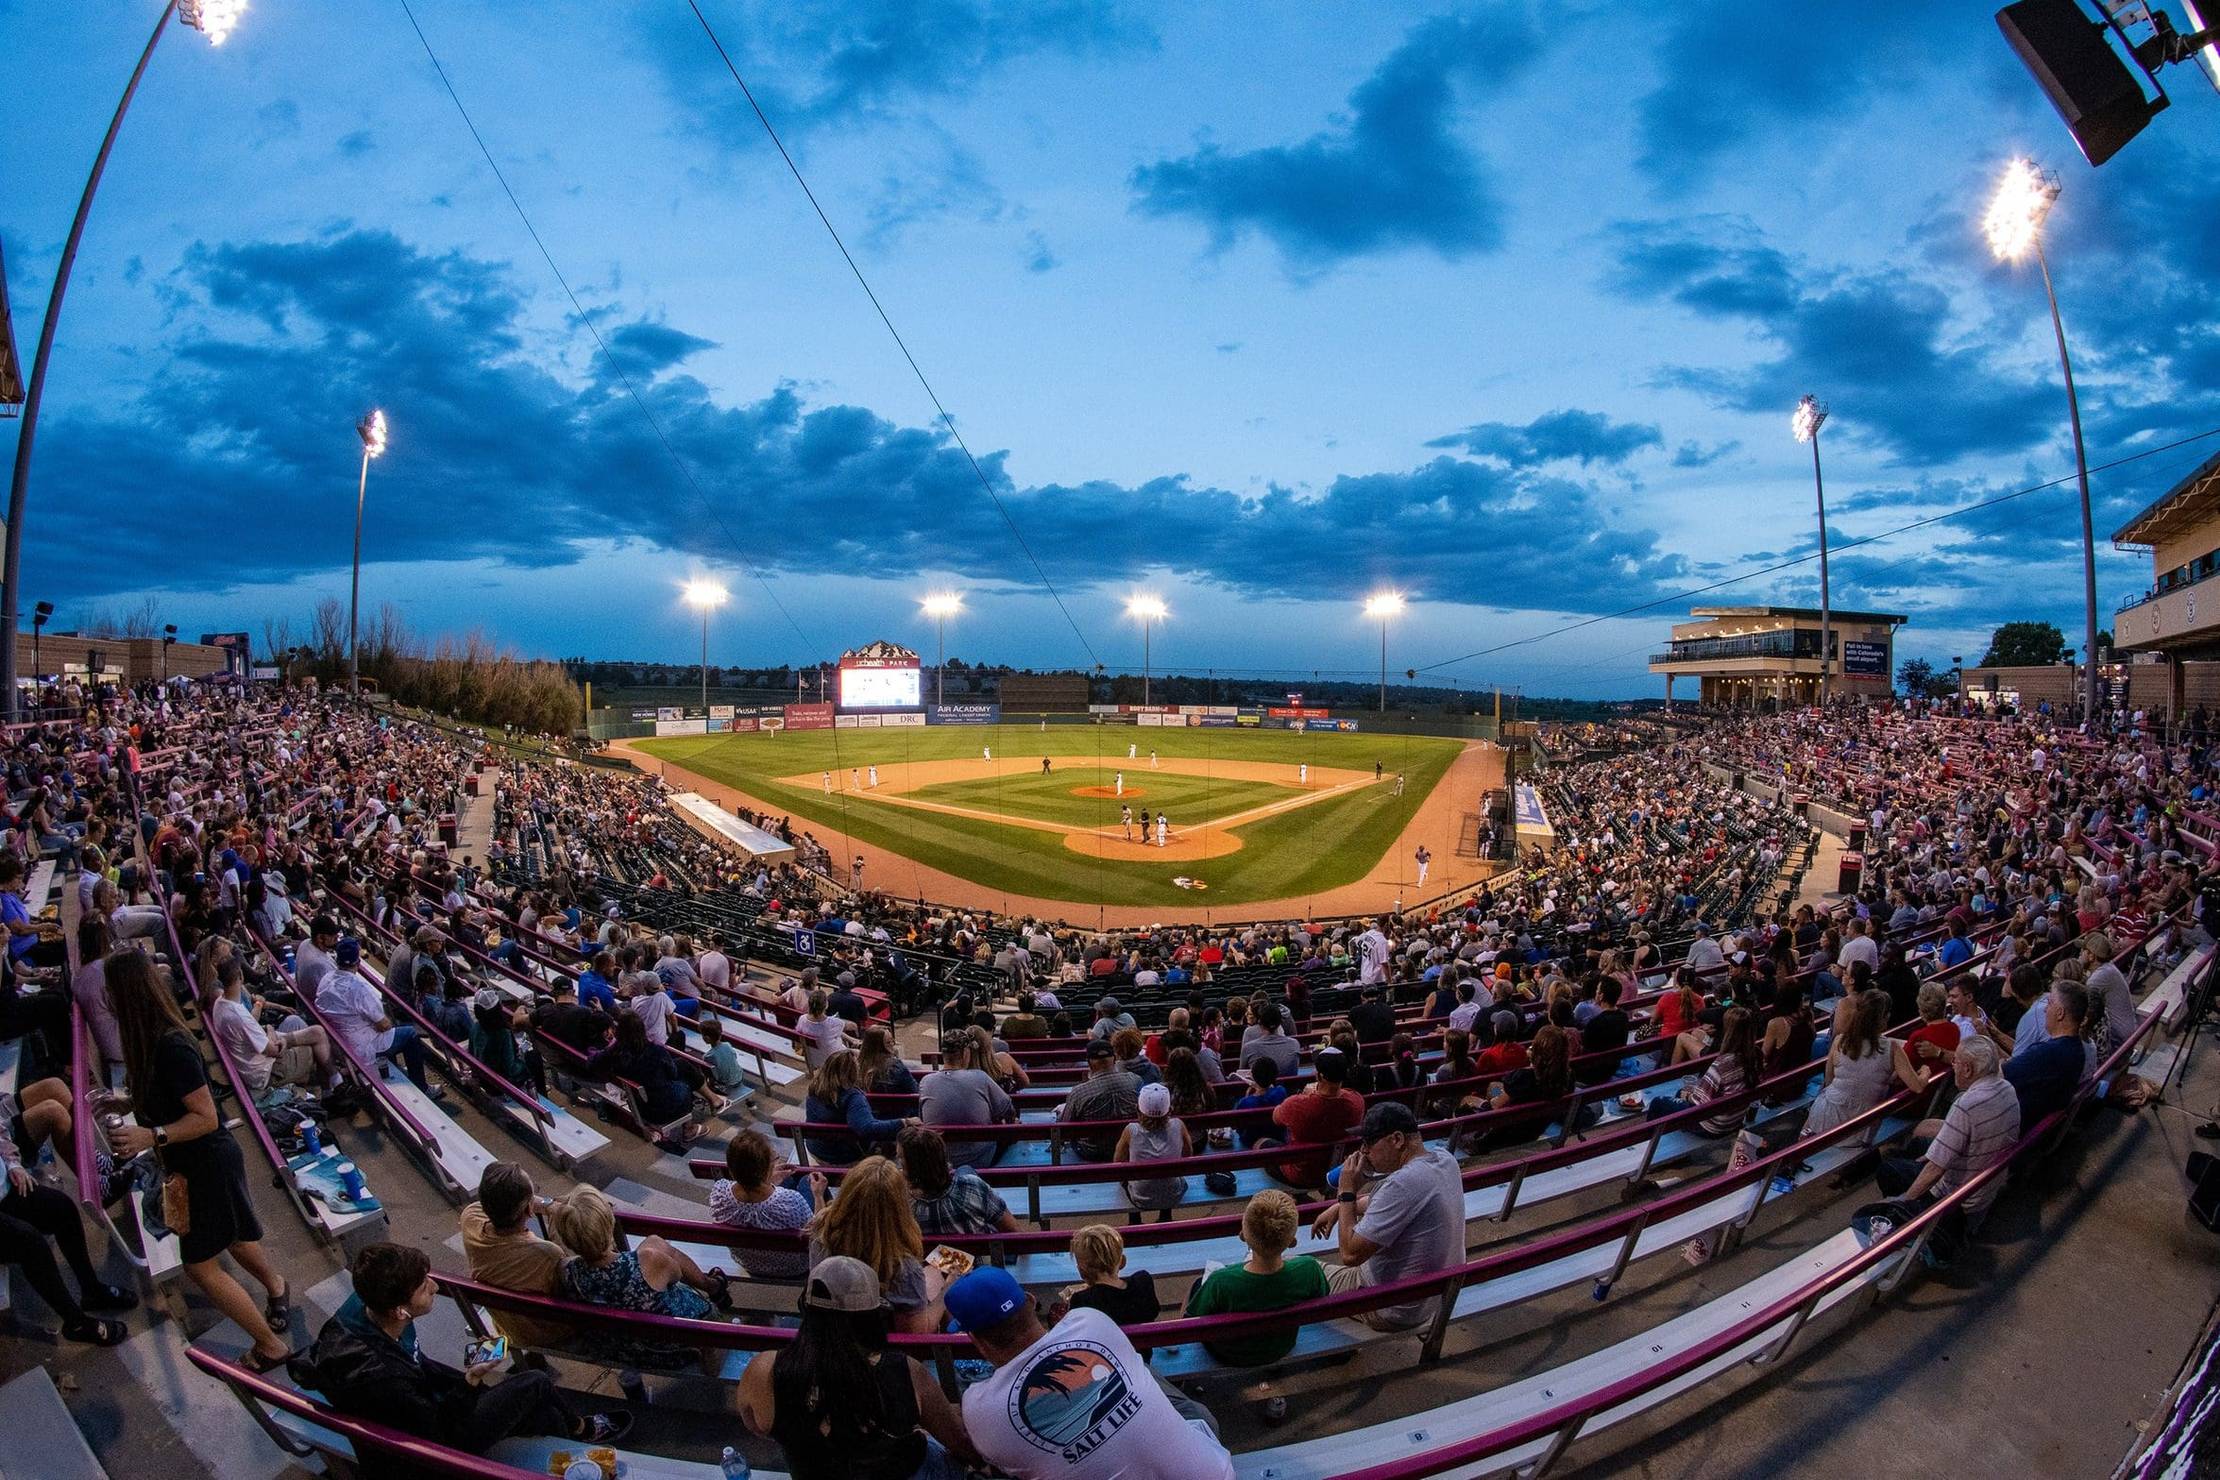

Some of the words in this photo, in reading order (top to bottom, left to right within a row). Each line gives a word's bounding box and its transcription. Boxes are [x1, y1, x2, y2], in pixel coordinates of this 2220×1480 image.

[953, 705, 991, 713] ACADEMY
[900, 715, 919, 723] DRC
[1038, 1342, 1091, 1360] ANCHOR
[1062, 1425, 1107, 1464] SALT
[1107, 1391, 1142, 1429] LIFE
[1414, 1433, 1423, 1441] 8
